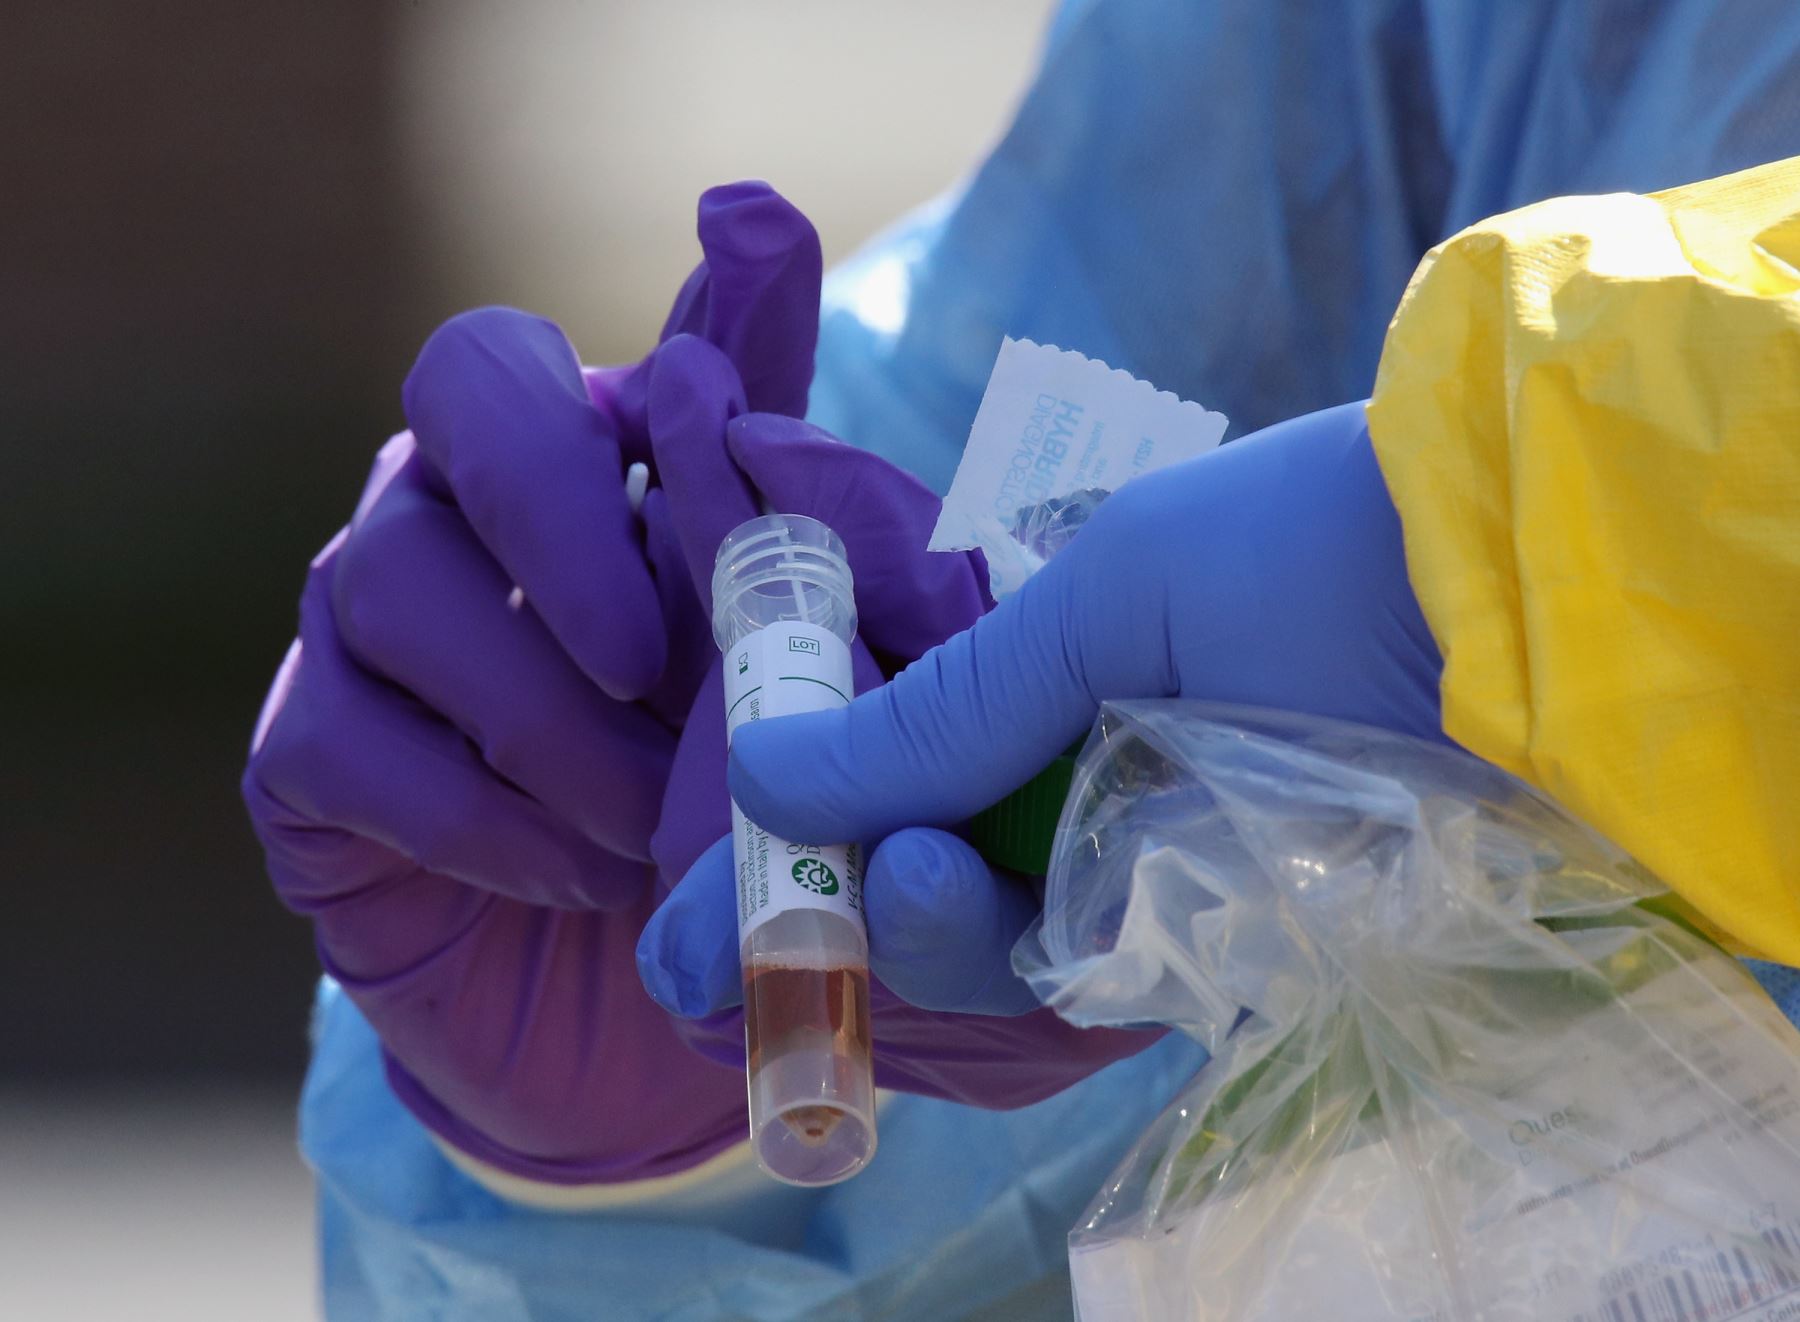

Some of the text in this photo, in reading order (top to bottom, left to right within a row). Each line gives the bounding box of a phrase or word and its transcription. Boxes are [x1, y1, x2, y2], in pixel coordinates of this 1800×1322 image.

[792, 640, 817, 651] LOT
[757, 849, 769, 870] Italy
[759, 880, 768, 908] Made
